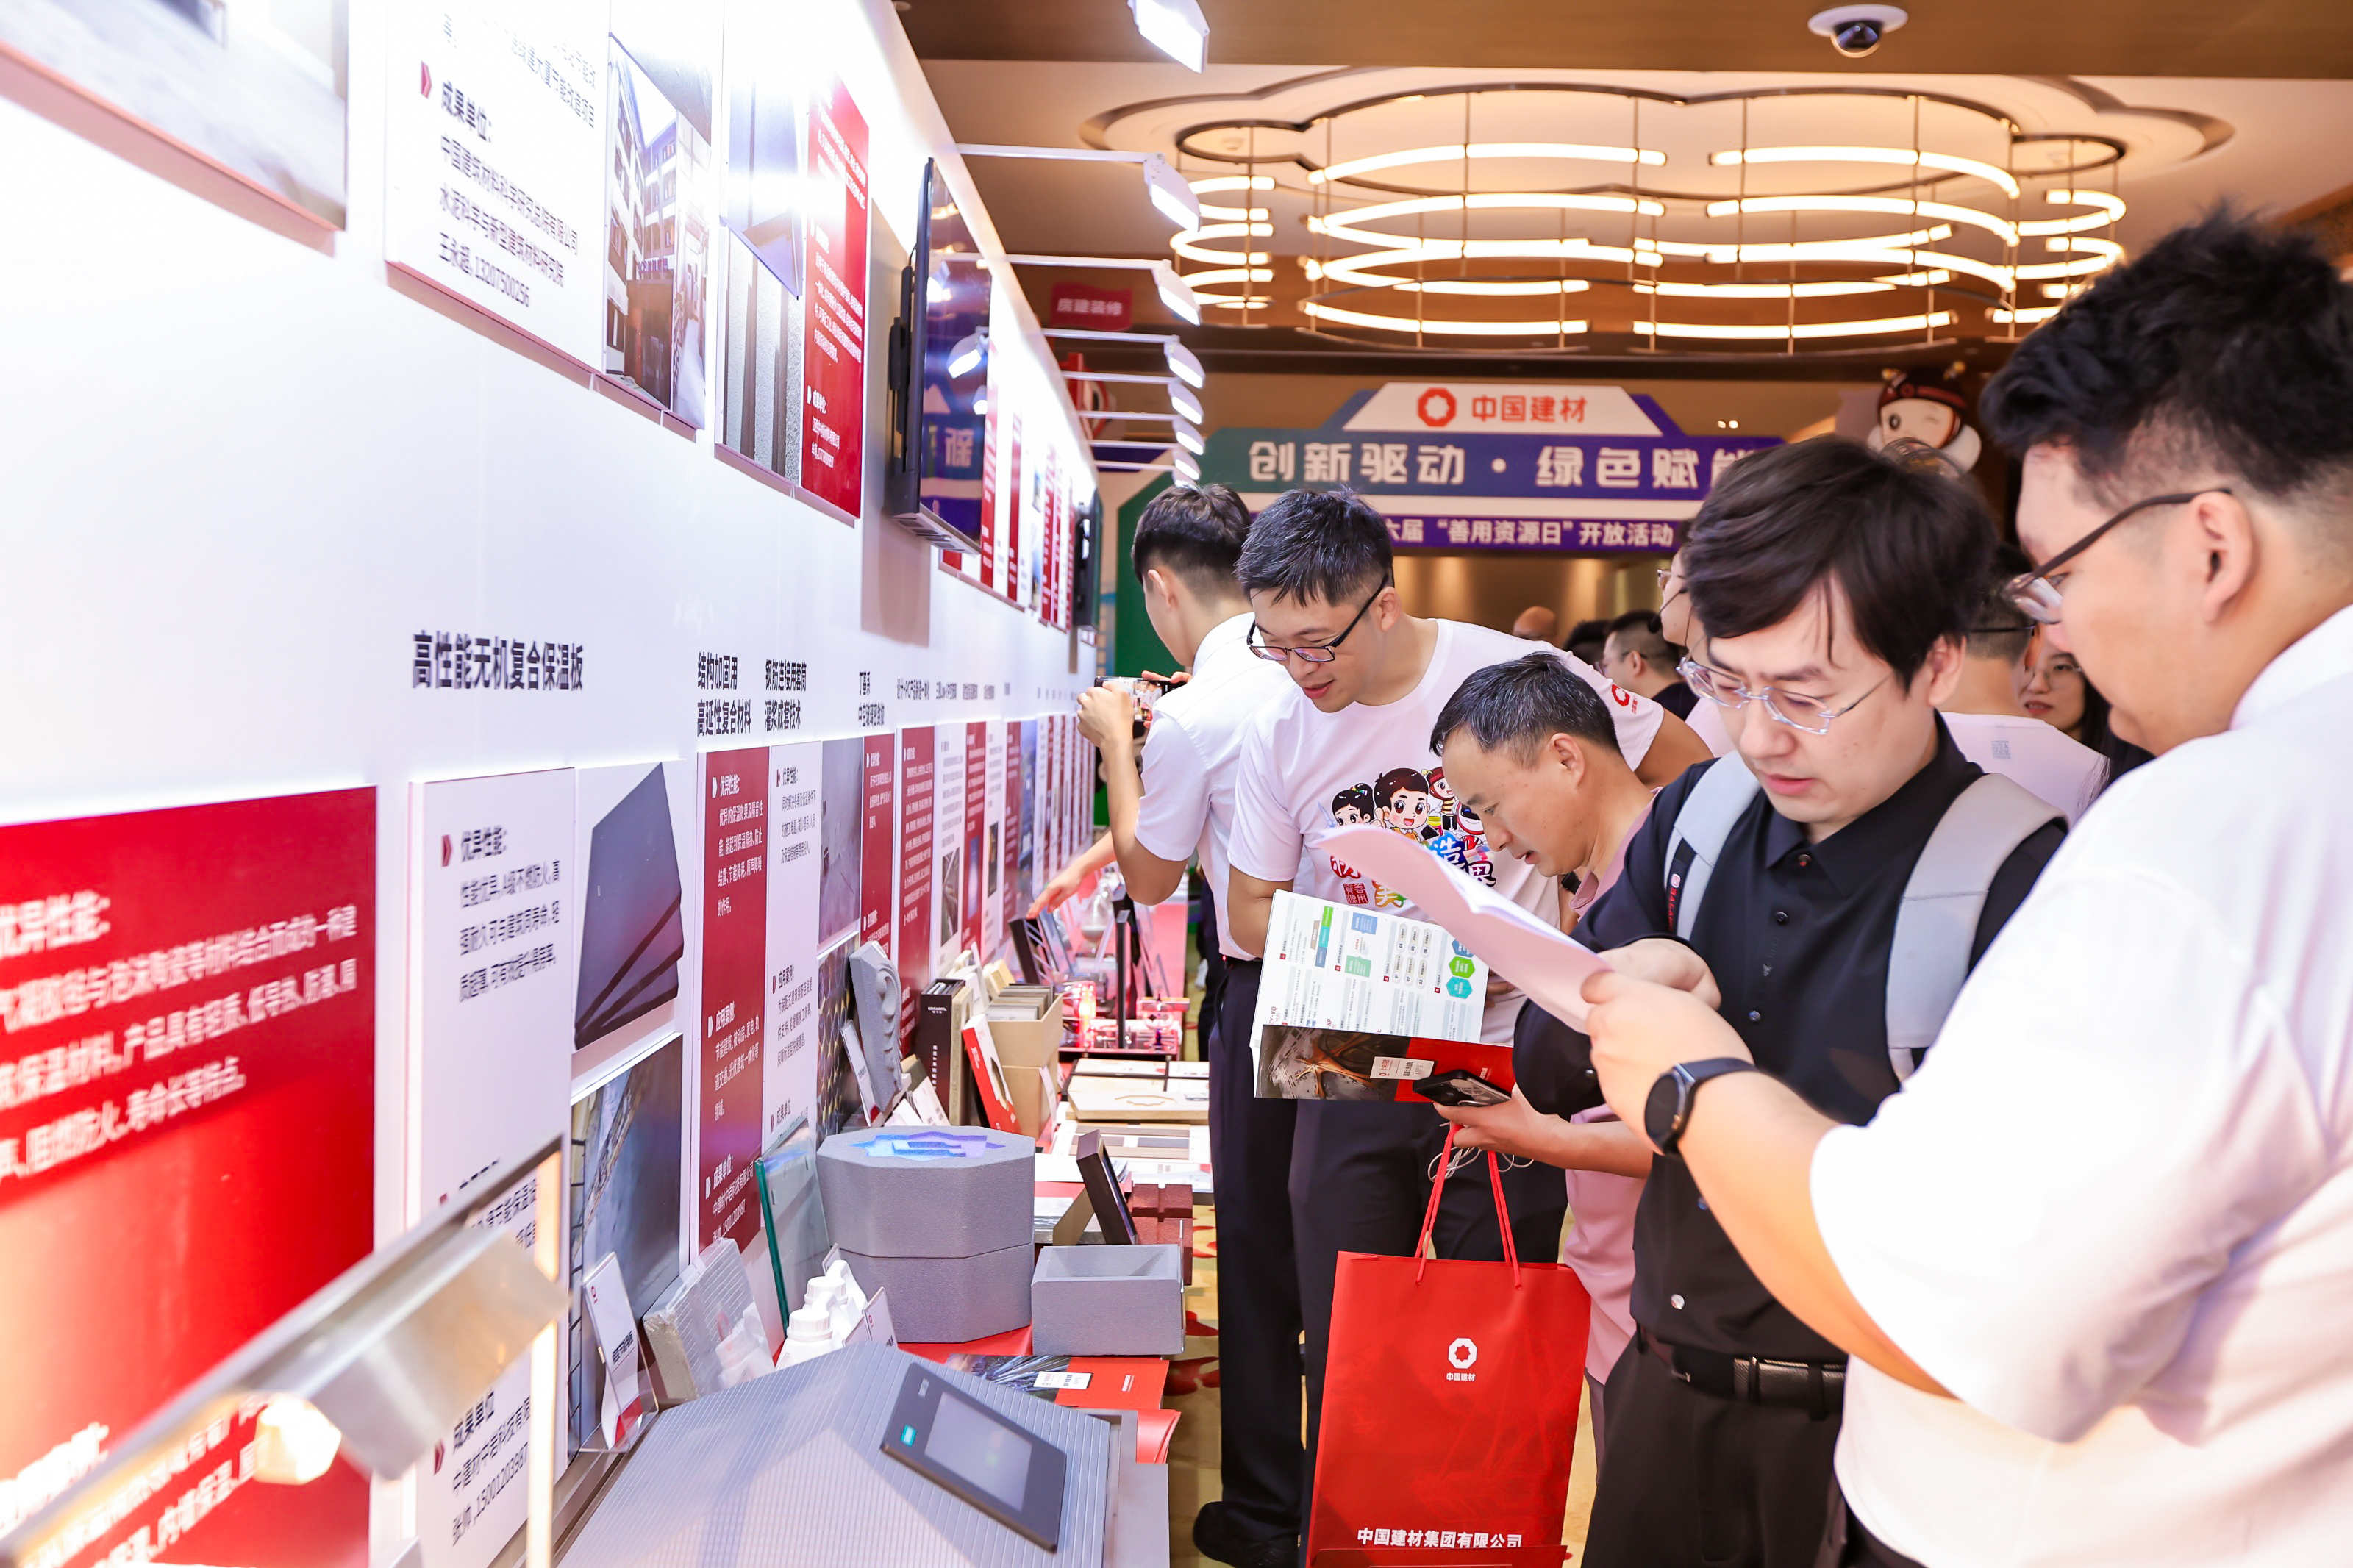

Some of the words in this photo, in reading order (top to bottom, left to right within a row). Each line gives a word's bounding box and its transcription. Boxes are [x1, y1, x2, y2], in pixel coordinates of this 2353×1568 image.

[1057, 298, 1122, 317] 房建装修
[1472, 395, 1588, 424] 中国建材
[413, 630, 584, 691] 高性能无机复合保温板
[697, 651, 738, 690] 结构加固用
[765, 659, 807, 691] 钢筋连接用套筒
[697, 699, 751, 737] 高延性复合材料
[765, 699, 801, 732] 灌浆成套技术
[1446, 1372, 1476, 1382] 中国建材
[1357, 1527, 1522, 1548] 中国建材集团有限公司
